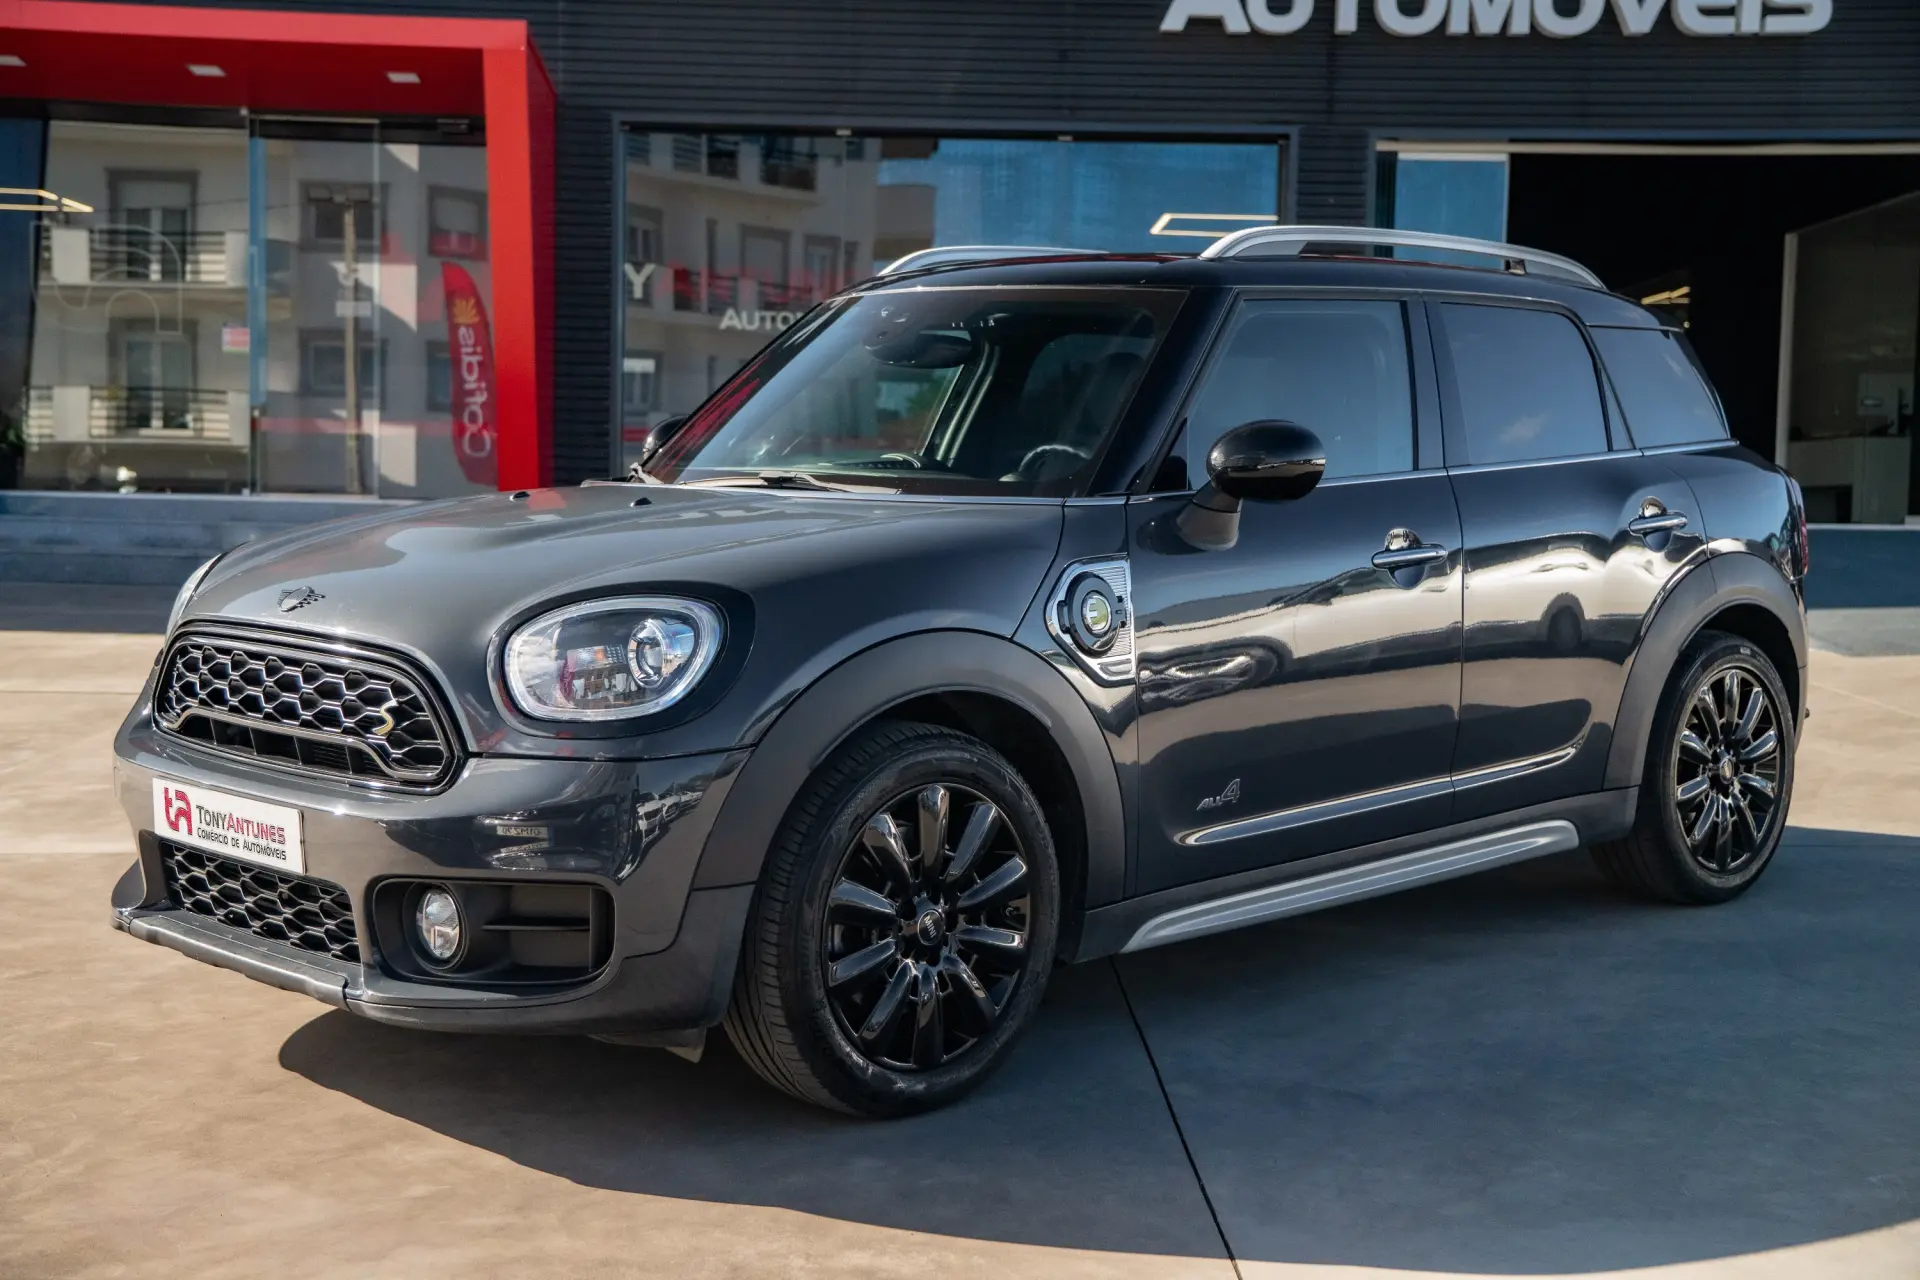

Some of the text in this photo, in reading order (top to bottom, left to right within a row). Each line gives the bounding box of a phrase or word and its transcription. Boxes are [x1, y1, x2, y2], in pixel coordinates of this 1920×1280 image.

[719, 308, 804, 331] AUTO
[231, 837, 240, 849] DE
[923, 914, 938, 938] MINI
